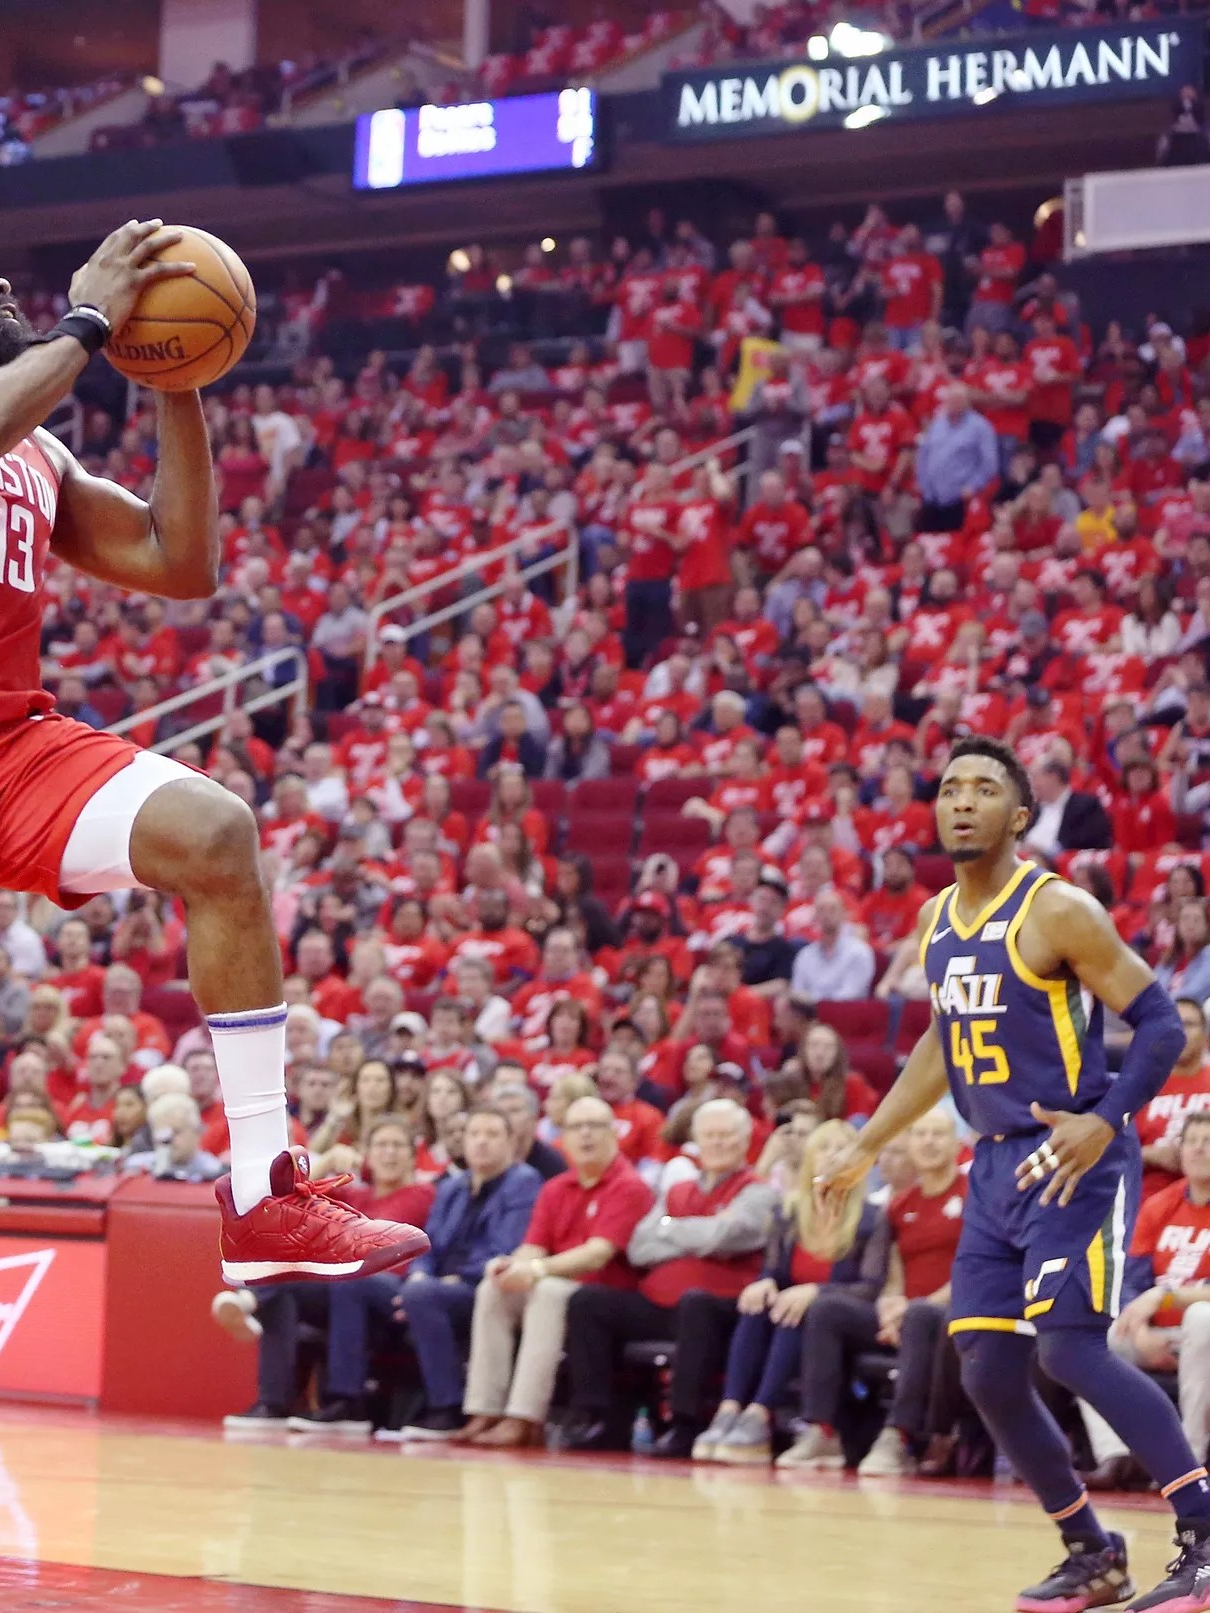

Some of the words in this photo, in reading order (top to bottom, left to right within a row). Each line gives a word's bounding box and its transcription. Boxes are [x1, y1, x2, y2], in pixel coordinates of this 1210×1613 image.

[677, 60, 913, 126] MEMORIAL
[926, 32, 1174, 102] HERMANN
[931, 955, 1008, 1016] JAZZ
[950, 1019, 1011, 1086] 45
